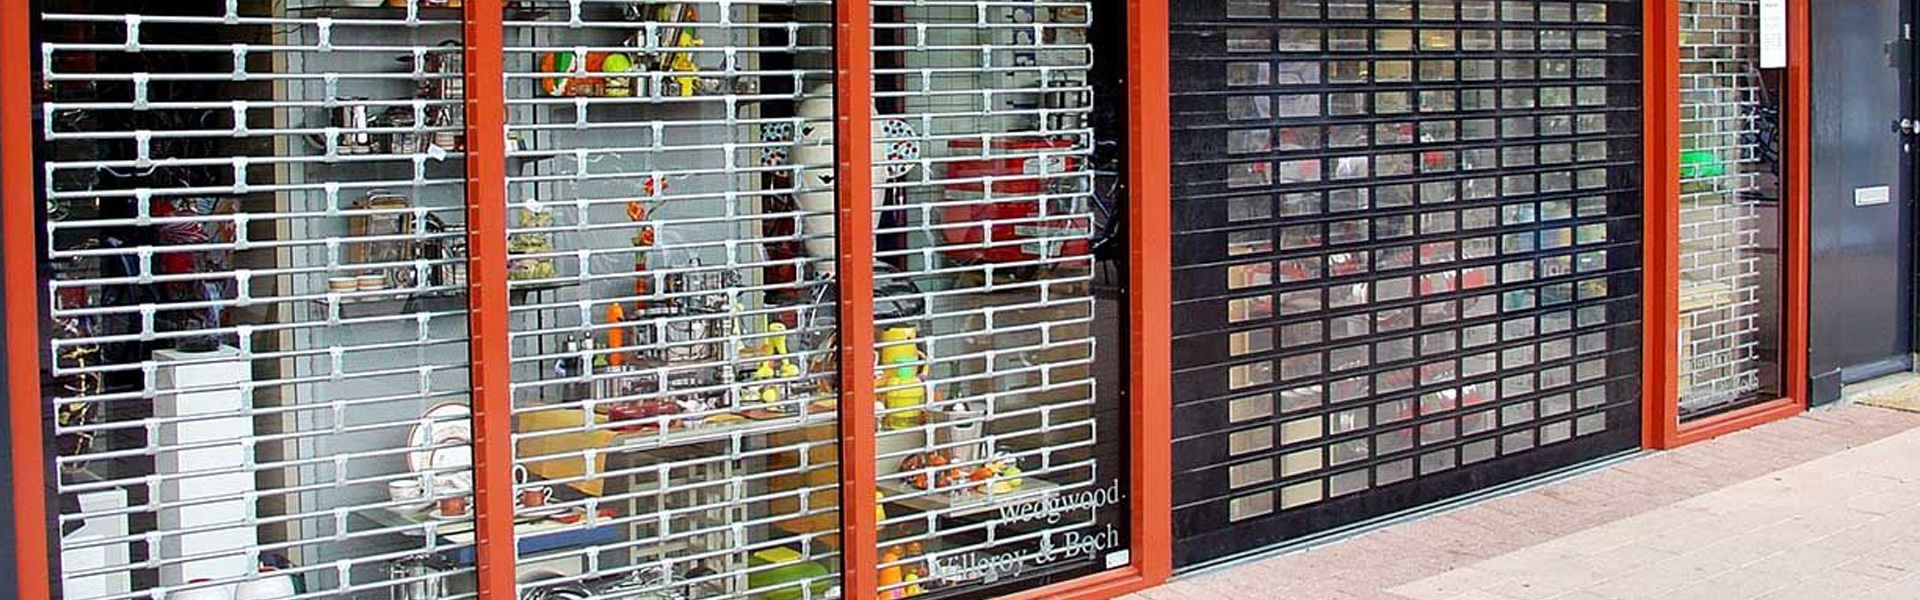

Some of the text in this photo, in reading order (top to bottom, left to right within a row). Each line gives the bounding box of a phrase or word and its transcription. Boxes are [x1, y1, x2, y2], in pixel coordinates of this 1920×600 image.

[999, 479, 1119, 525] Wedgwood
[933, 524, 1119, 584] Villeroy & Boch
